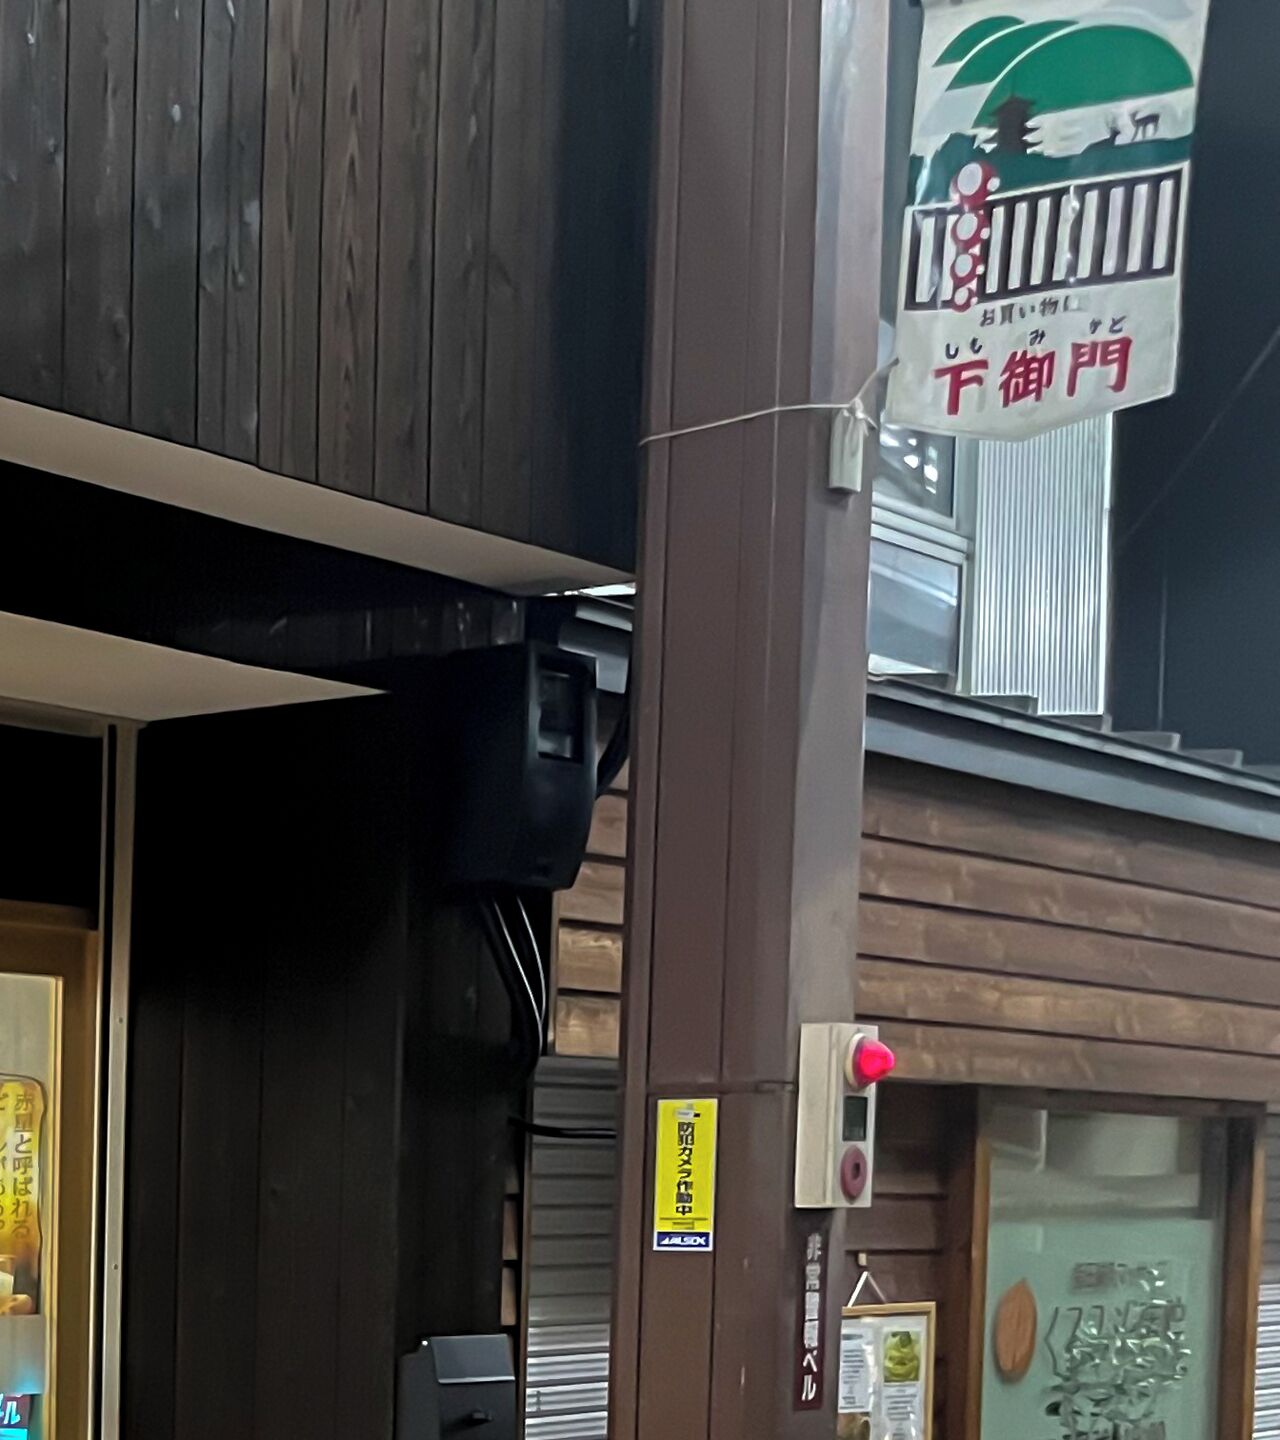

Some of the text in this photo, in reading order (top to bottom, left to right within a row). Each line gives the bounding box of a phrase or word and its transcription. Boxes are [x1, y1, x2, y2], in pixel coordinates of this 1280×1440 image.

[934, 336, 1133, 415] 下御門
[676, 1122, 695, 1215] 防犯カメラ作動中
